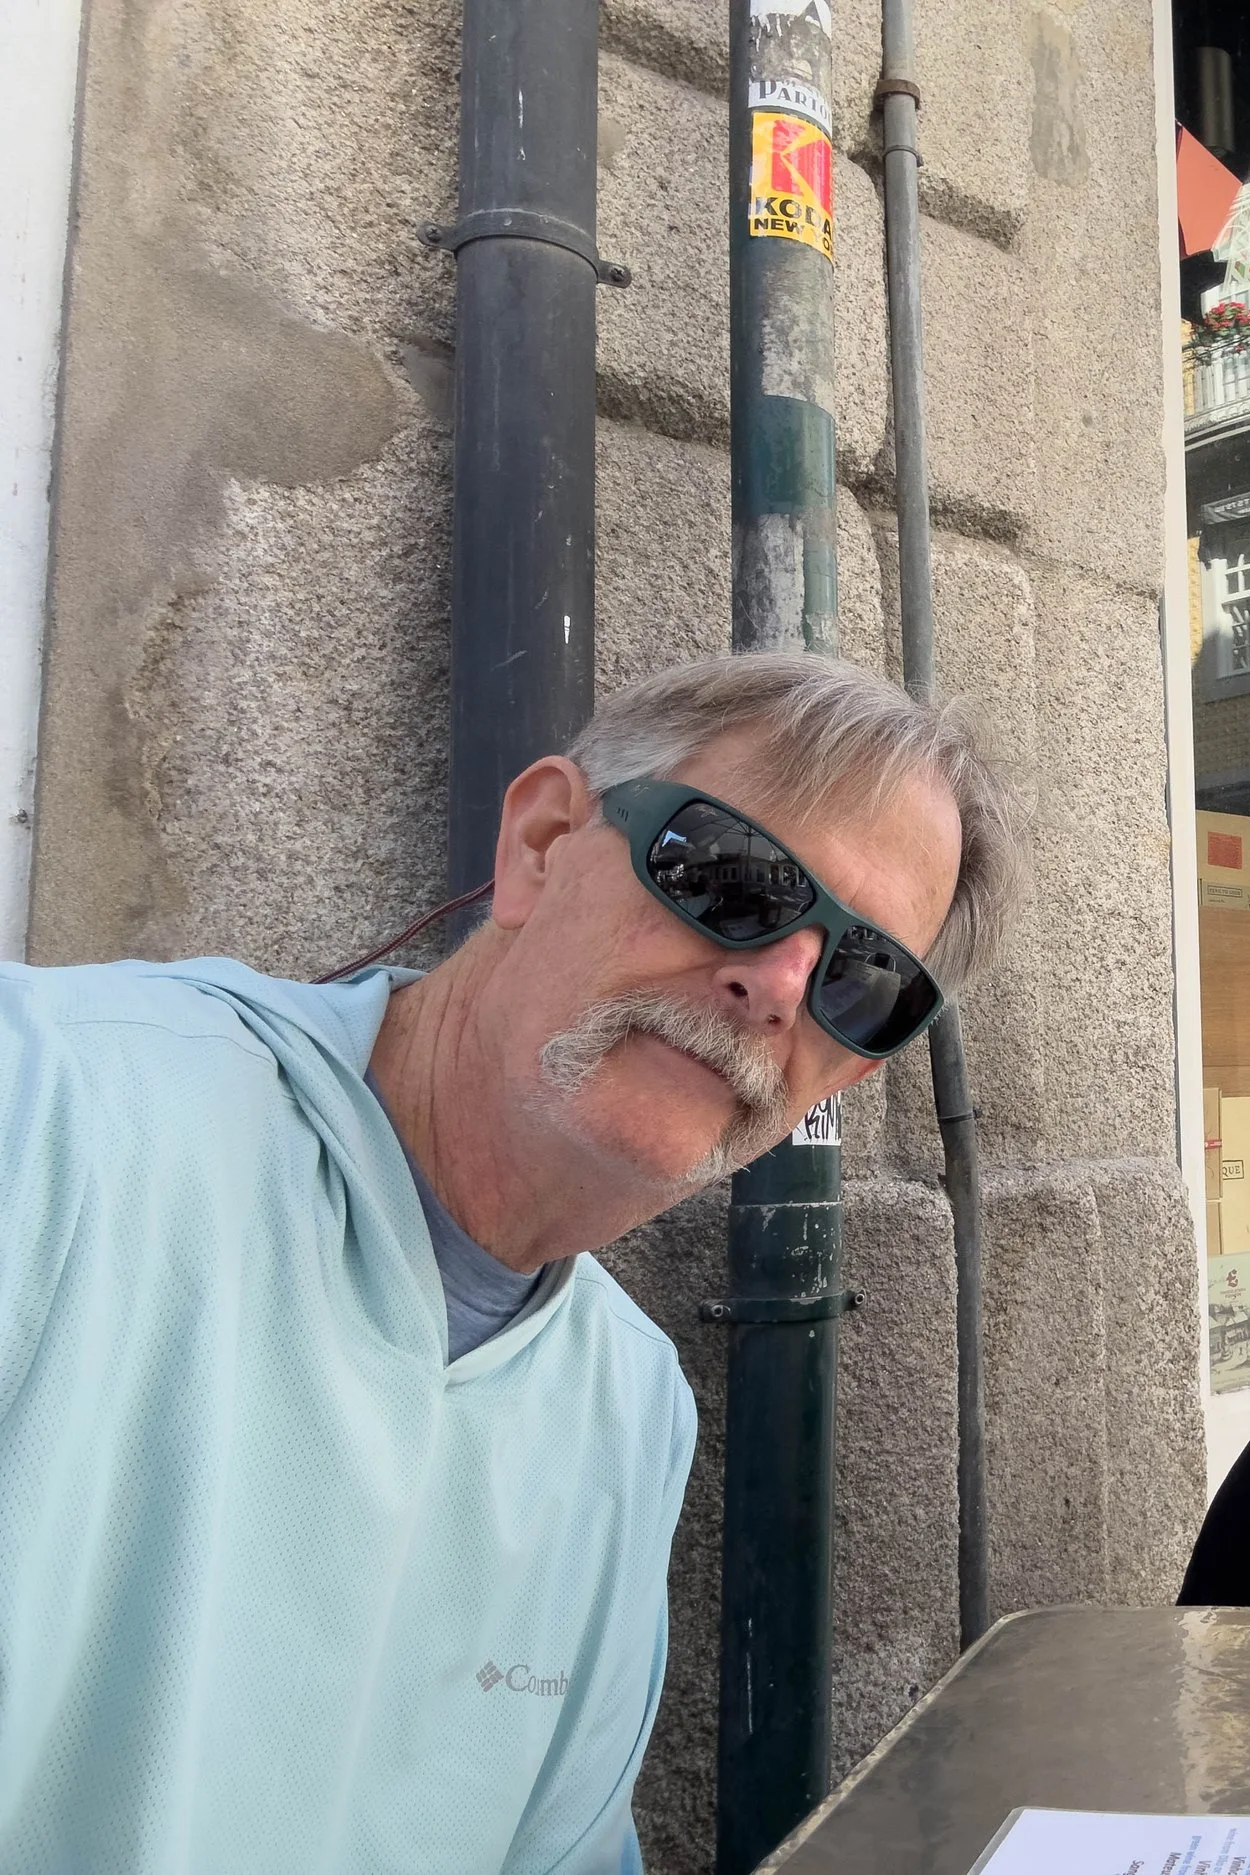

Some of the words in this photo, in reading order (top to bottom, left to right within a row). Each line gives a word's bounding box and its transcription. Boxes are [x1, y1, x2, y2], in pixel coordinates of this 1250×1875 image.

[759, 80, 831, 125] PARTO
[755, 197, 832, 239] KODA
[1222, 1165, 1241, 1178] QUE
